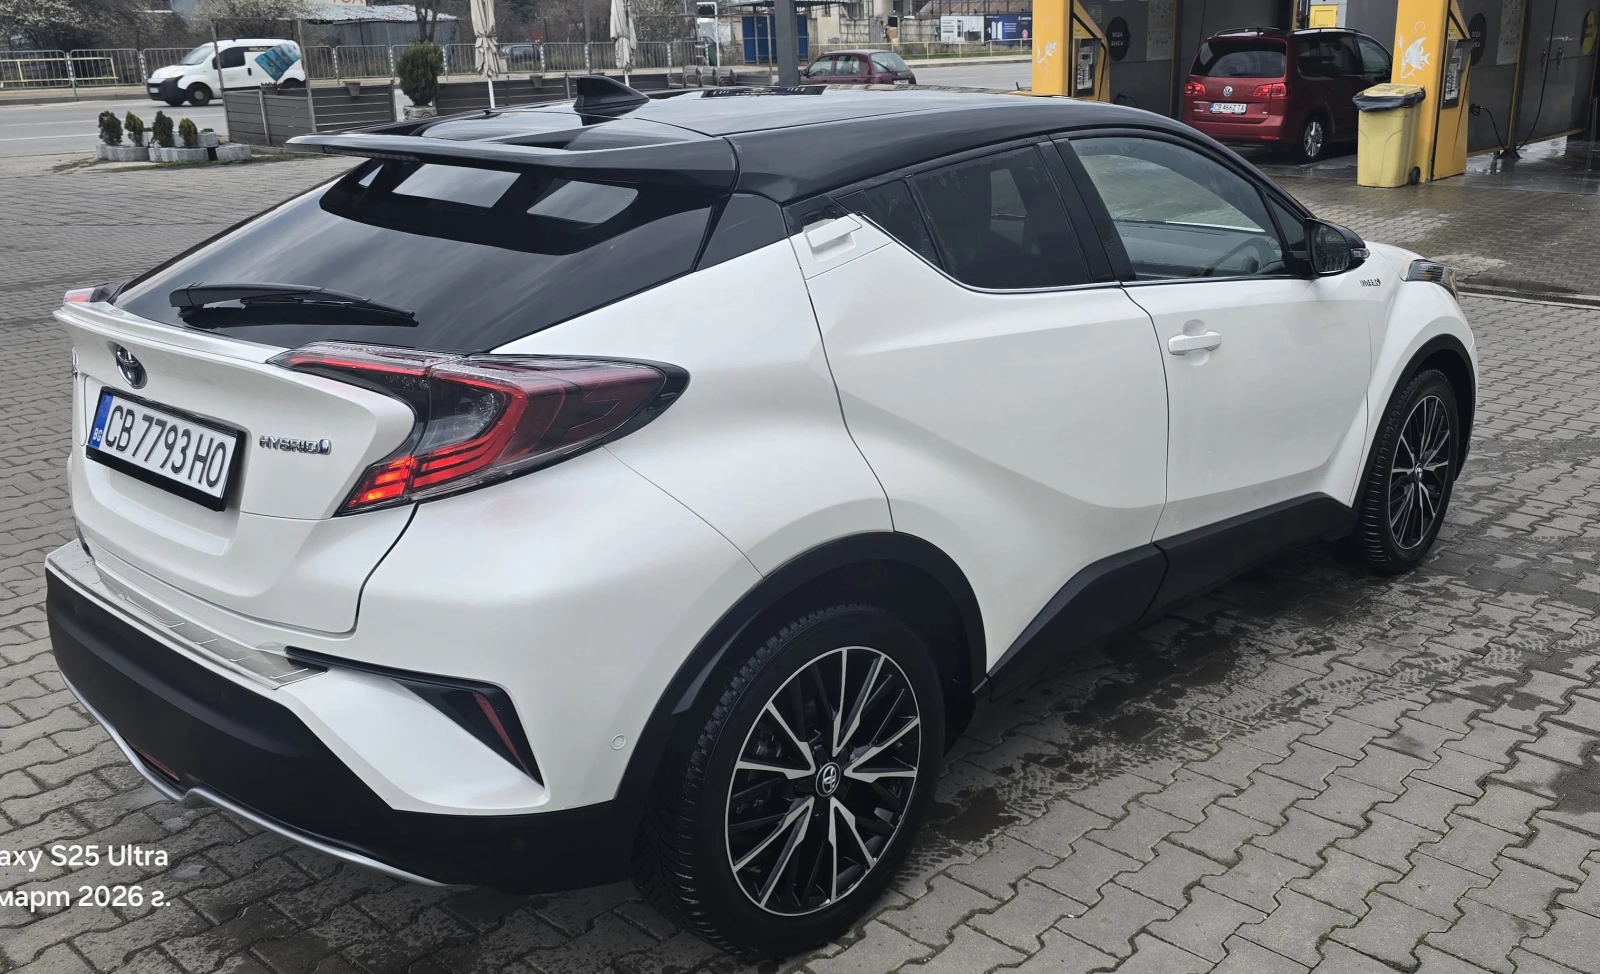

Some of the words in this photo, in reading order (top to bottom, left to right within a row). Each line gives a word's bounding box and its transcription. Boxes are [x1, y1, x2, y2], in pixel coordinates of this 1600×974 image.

[92, 427, 103, 442] BG
[104, 405, 135, 452] CB
[132, 413, 192, 475] 7793
[187, 433, 227, 488] HO
[259, 435, 320, 454] HYBRID
